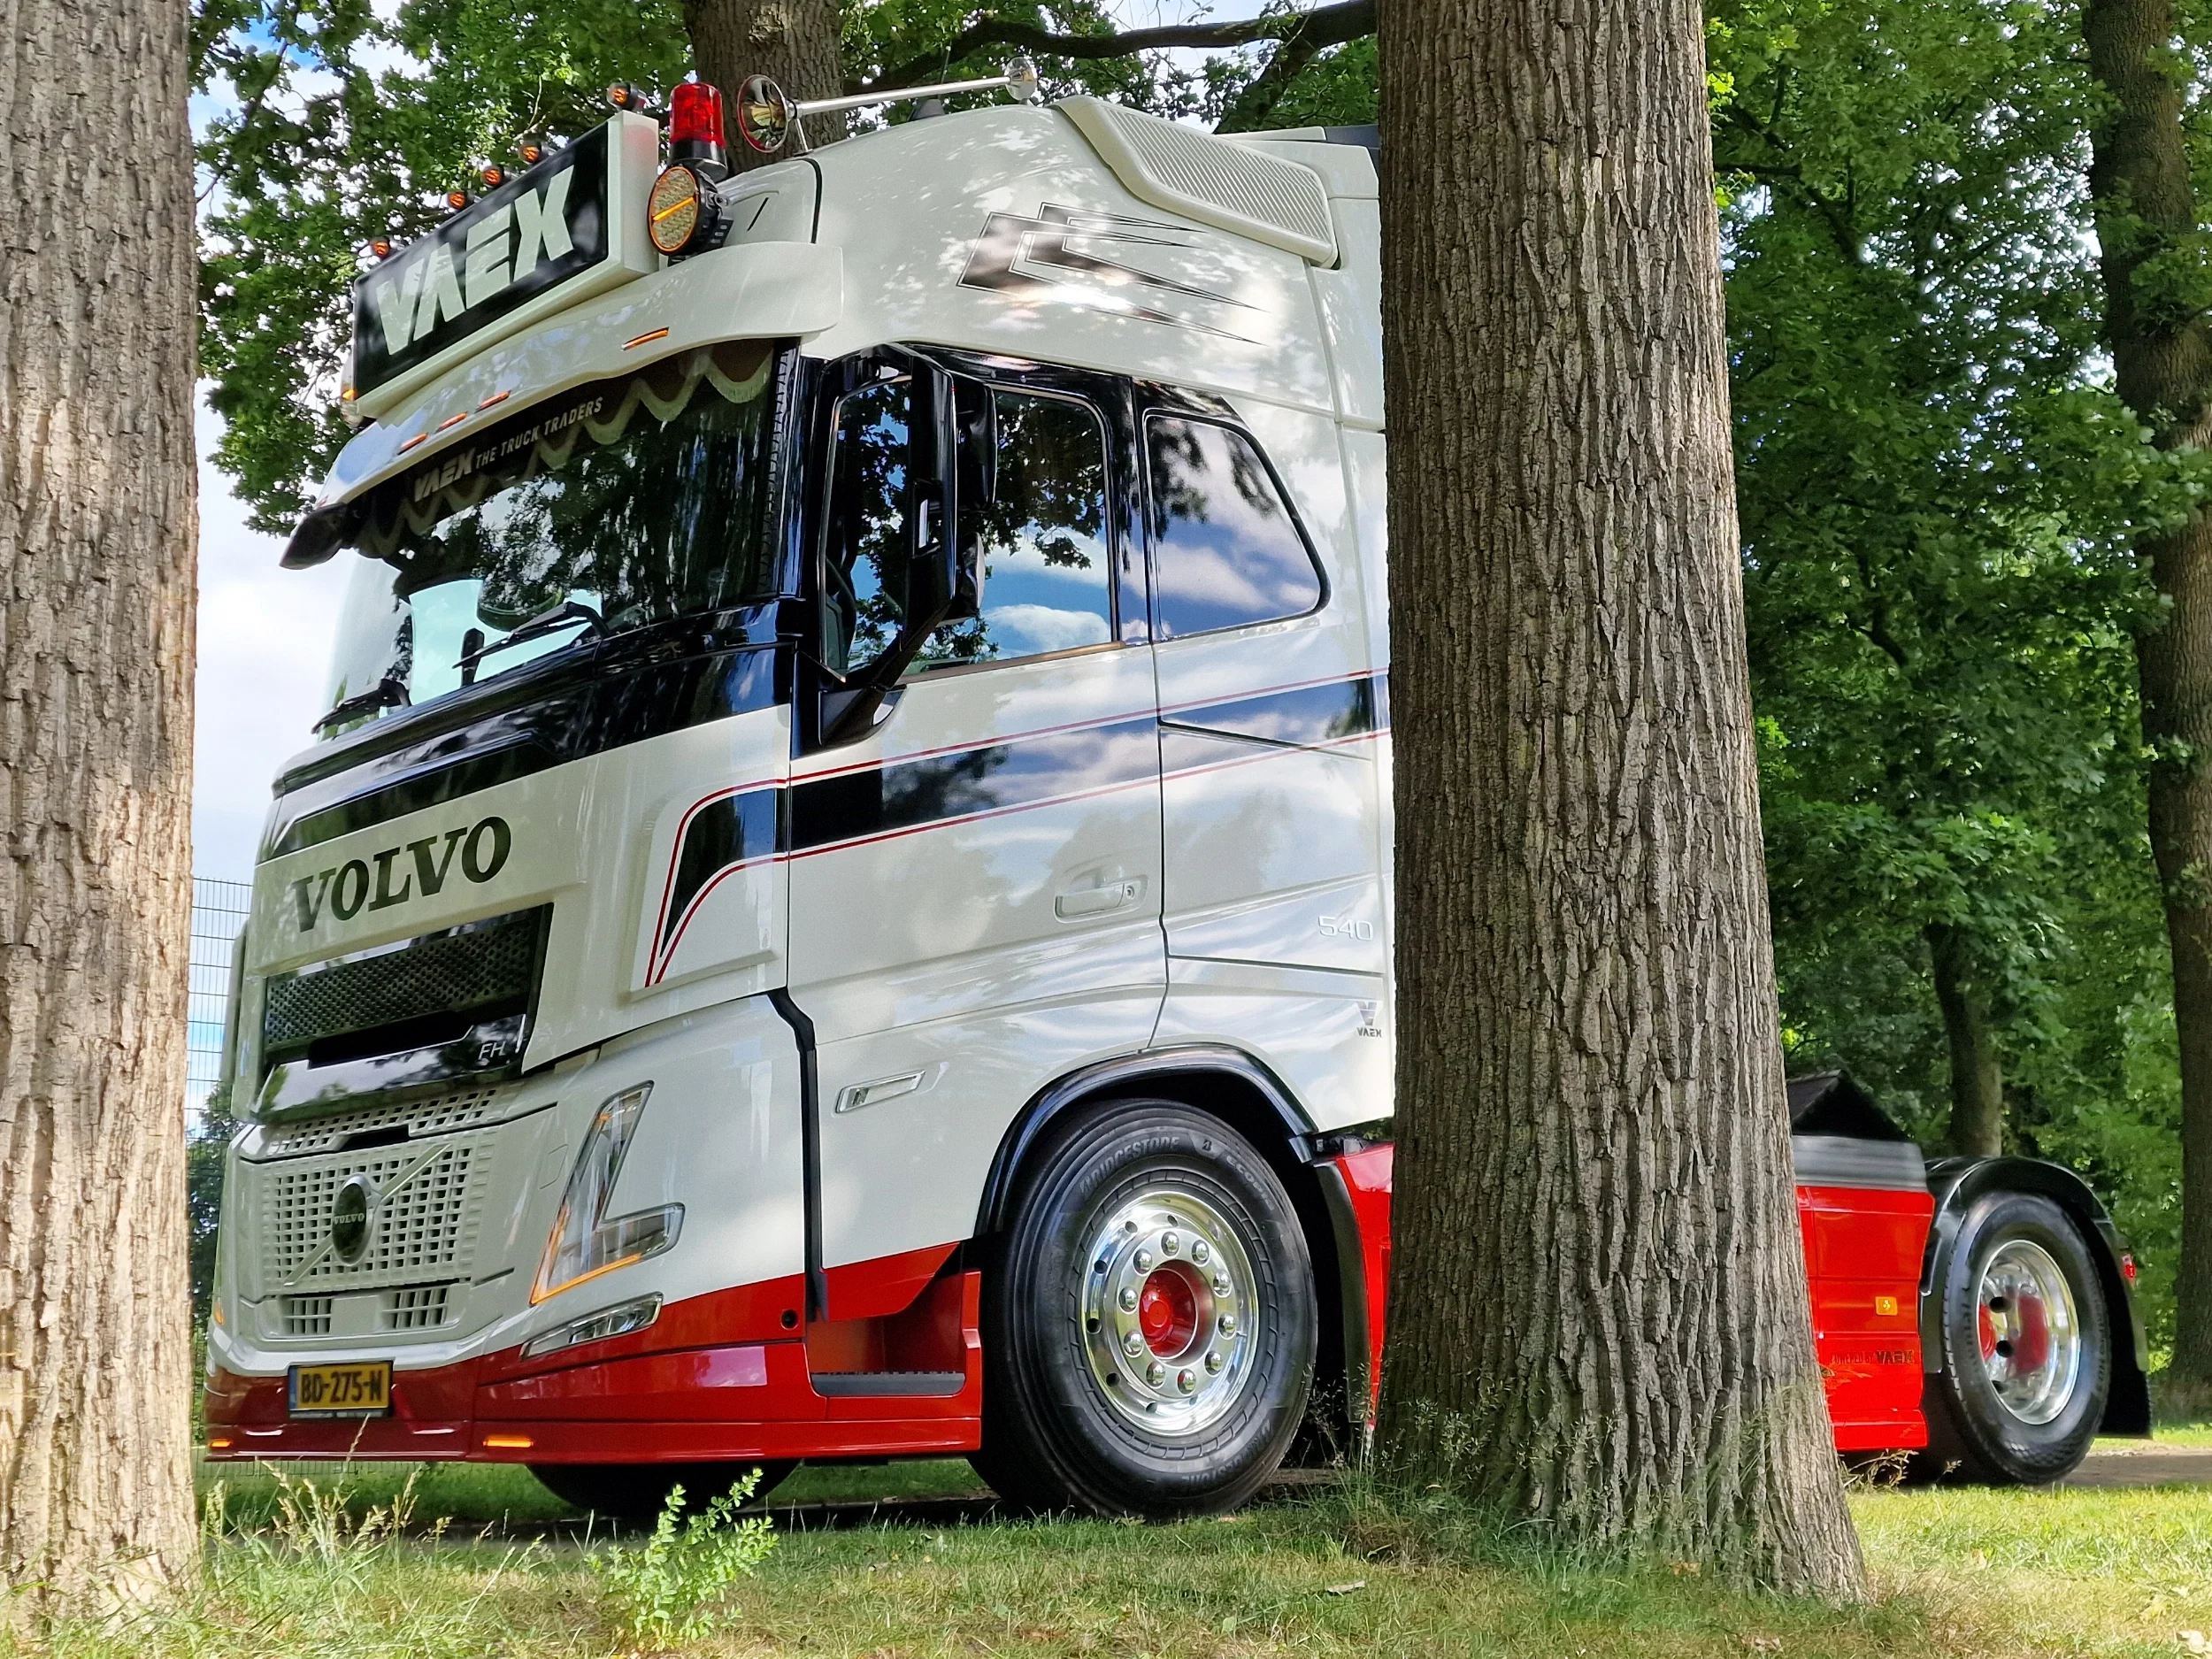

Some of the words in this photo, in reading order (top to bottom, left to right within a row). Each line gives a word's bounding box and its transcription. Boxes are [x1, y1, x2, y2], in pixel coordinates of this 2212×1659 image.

[375, 165, 574, 356] VAEX
[414, 448, 475, 502] VAEX
[476, 449, 495, 469] THE
[501, 425, 539, 457] TRUCK
[544, 396, 603, 434] TRADERS
[291, 816, 511, 933] VOLVO
[1318, 915, 1373, 941] 540
[1357, 1027, 1382, 1038] VAEX
[478, 1041, 506, 1060] FH
[1080, 1136, 1179, 1194] BRIDGESTONE
[334, 1213, 365, 1225] VOLVO
[301, 1370, 382, 1403] BD-275-N
